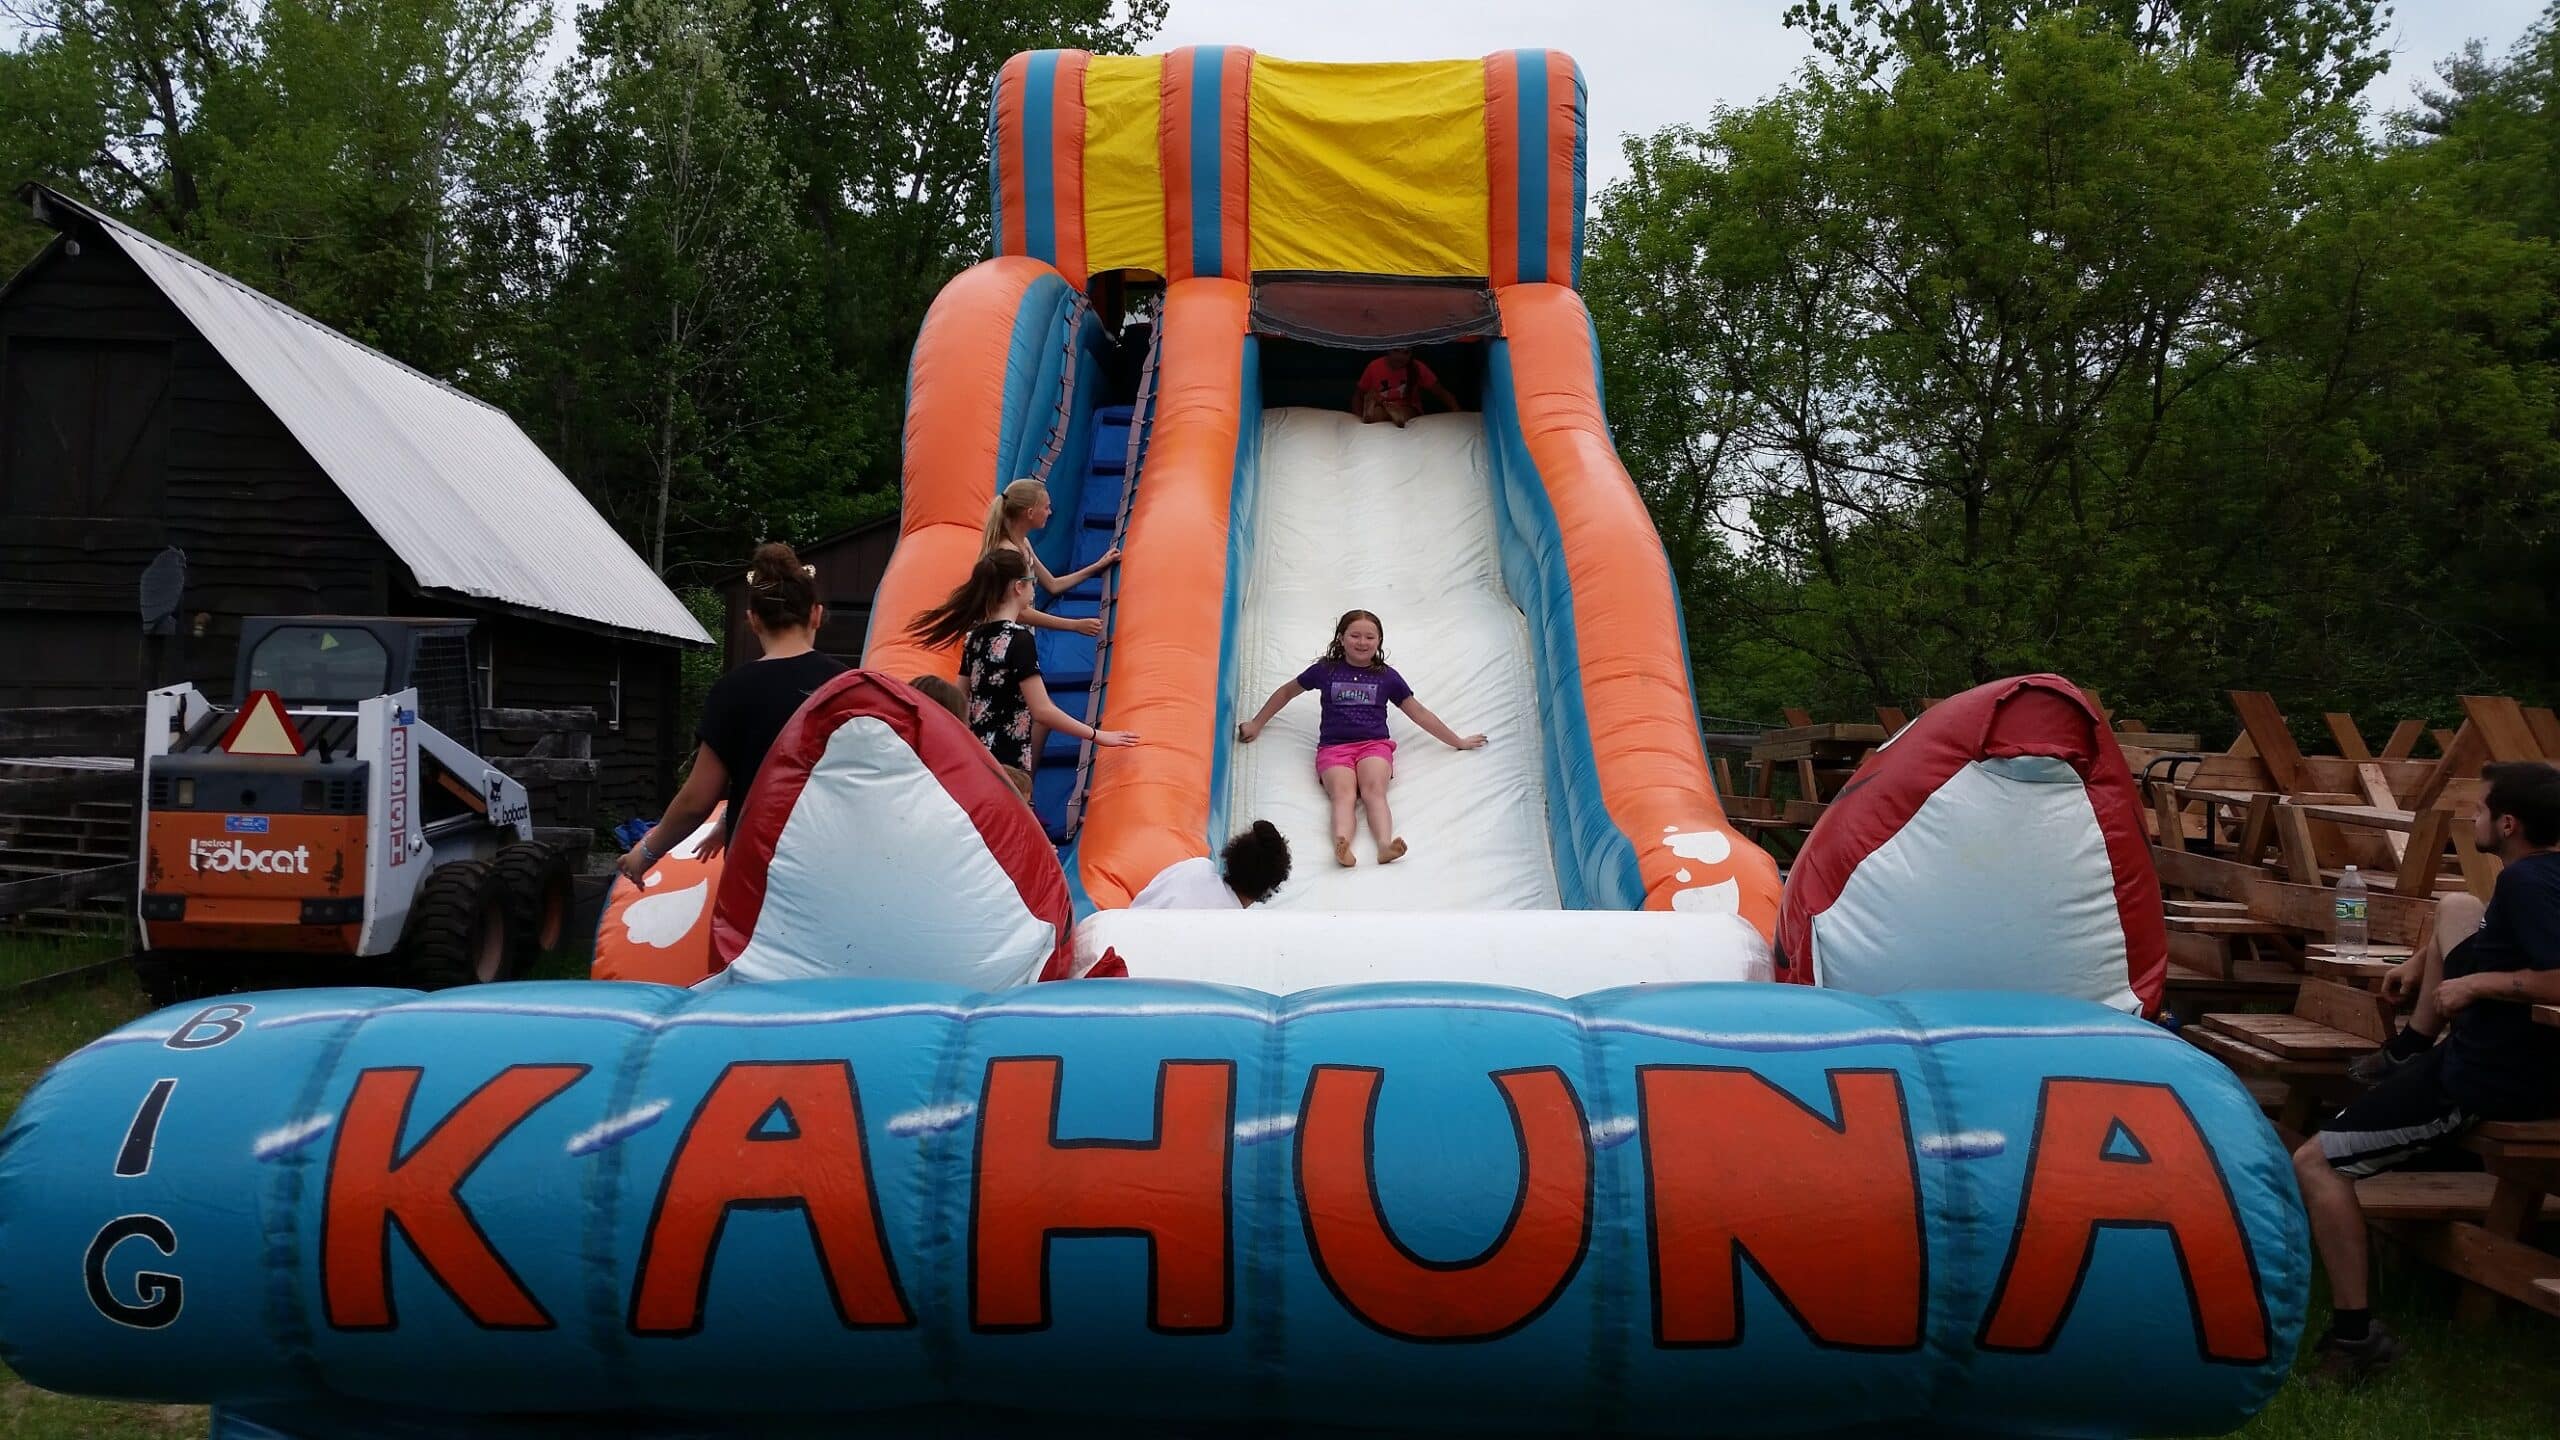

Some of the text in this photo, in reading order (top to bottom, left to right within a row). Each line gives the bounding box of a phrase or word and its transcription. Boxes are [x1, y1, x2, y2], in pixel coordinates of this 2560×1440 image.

[190, 838, 310, 874] bobcat
[390, 728, 407, 868] 853H
[502, 803, 528, 823] bobcat
[83, 1003, 255, 1330] BIG
[324, 1056, 2271, 1364] KAHUNA
